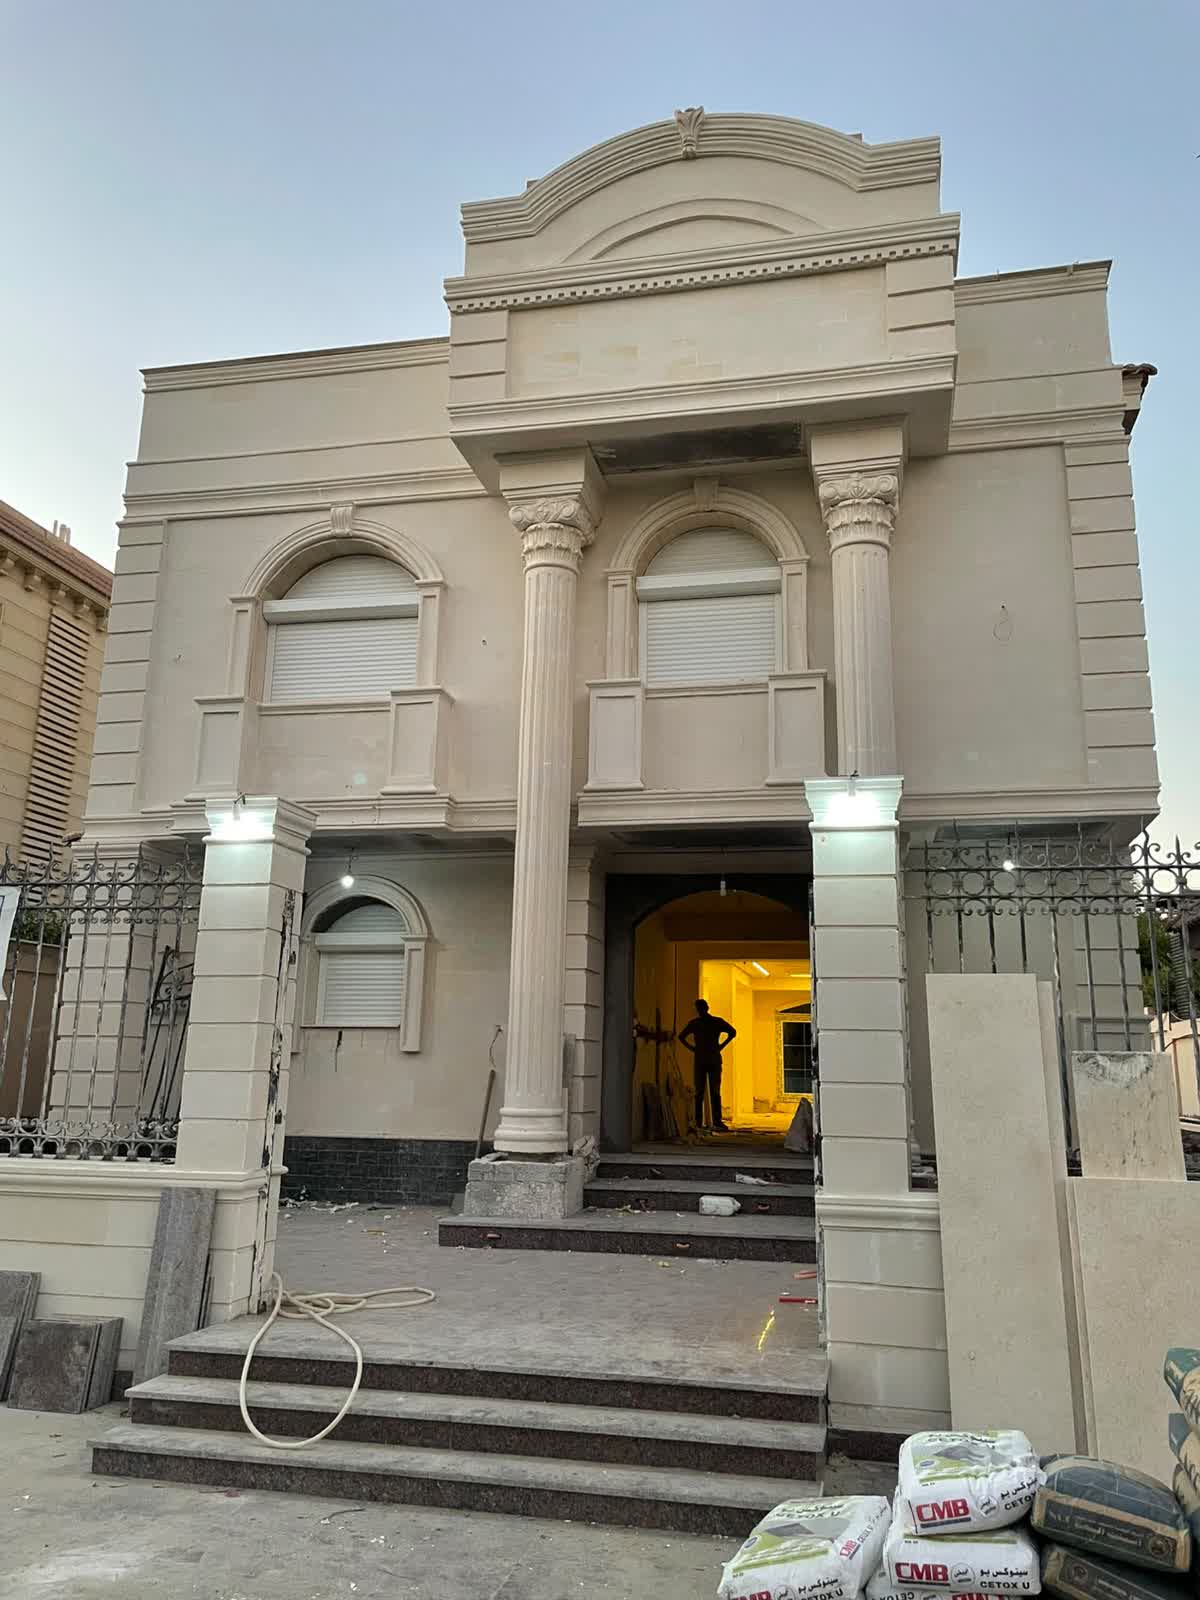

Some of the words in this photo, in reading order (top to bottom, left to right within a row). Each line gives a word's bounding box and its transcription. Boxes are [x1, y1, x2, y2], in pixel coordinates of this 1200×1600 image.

[916, 1499, 970, 1522] CMB
[895, 1562, 949, 1582] CMB
[835, 1587, 844, 1597] U
[980, 1580, 1018, 1589] CETOX
[1022, 1581, 1030, 1590] U
